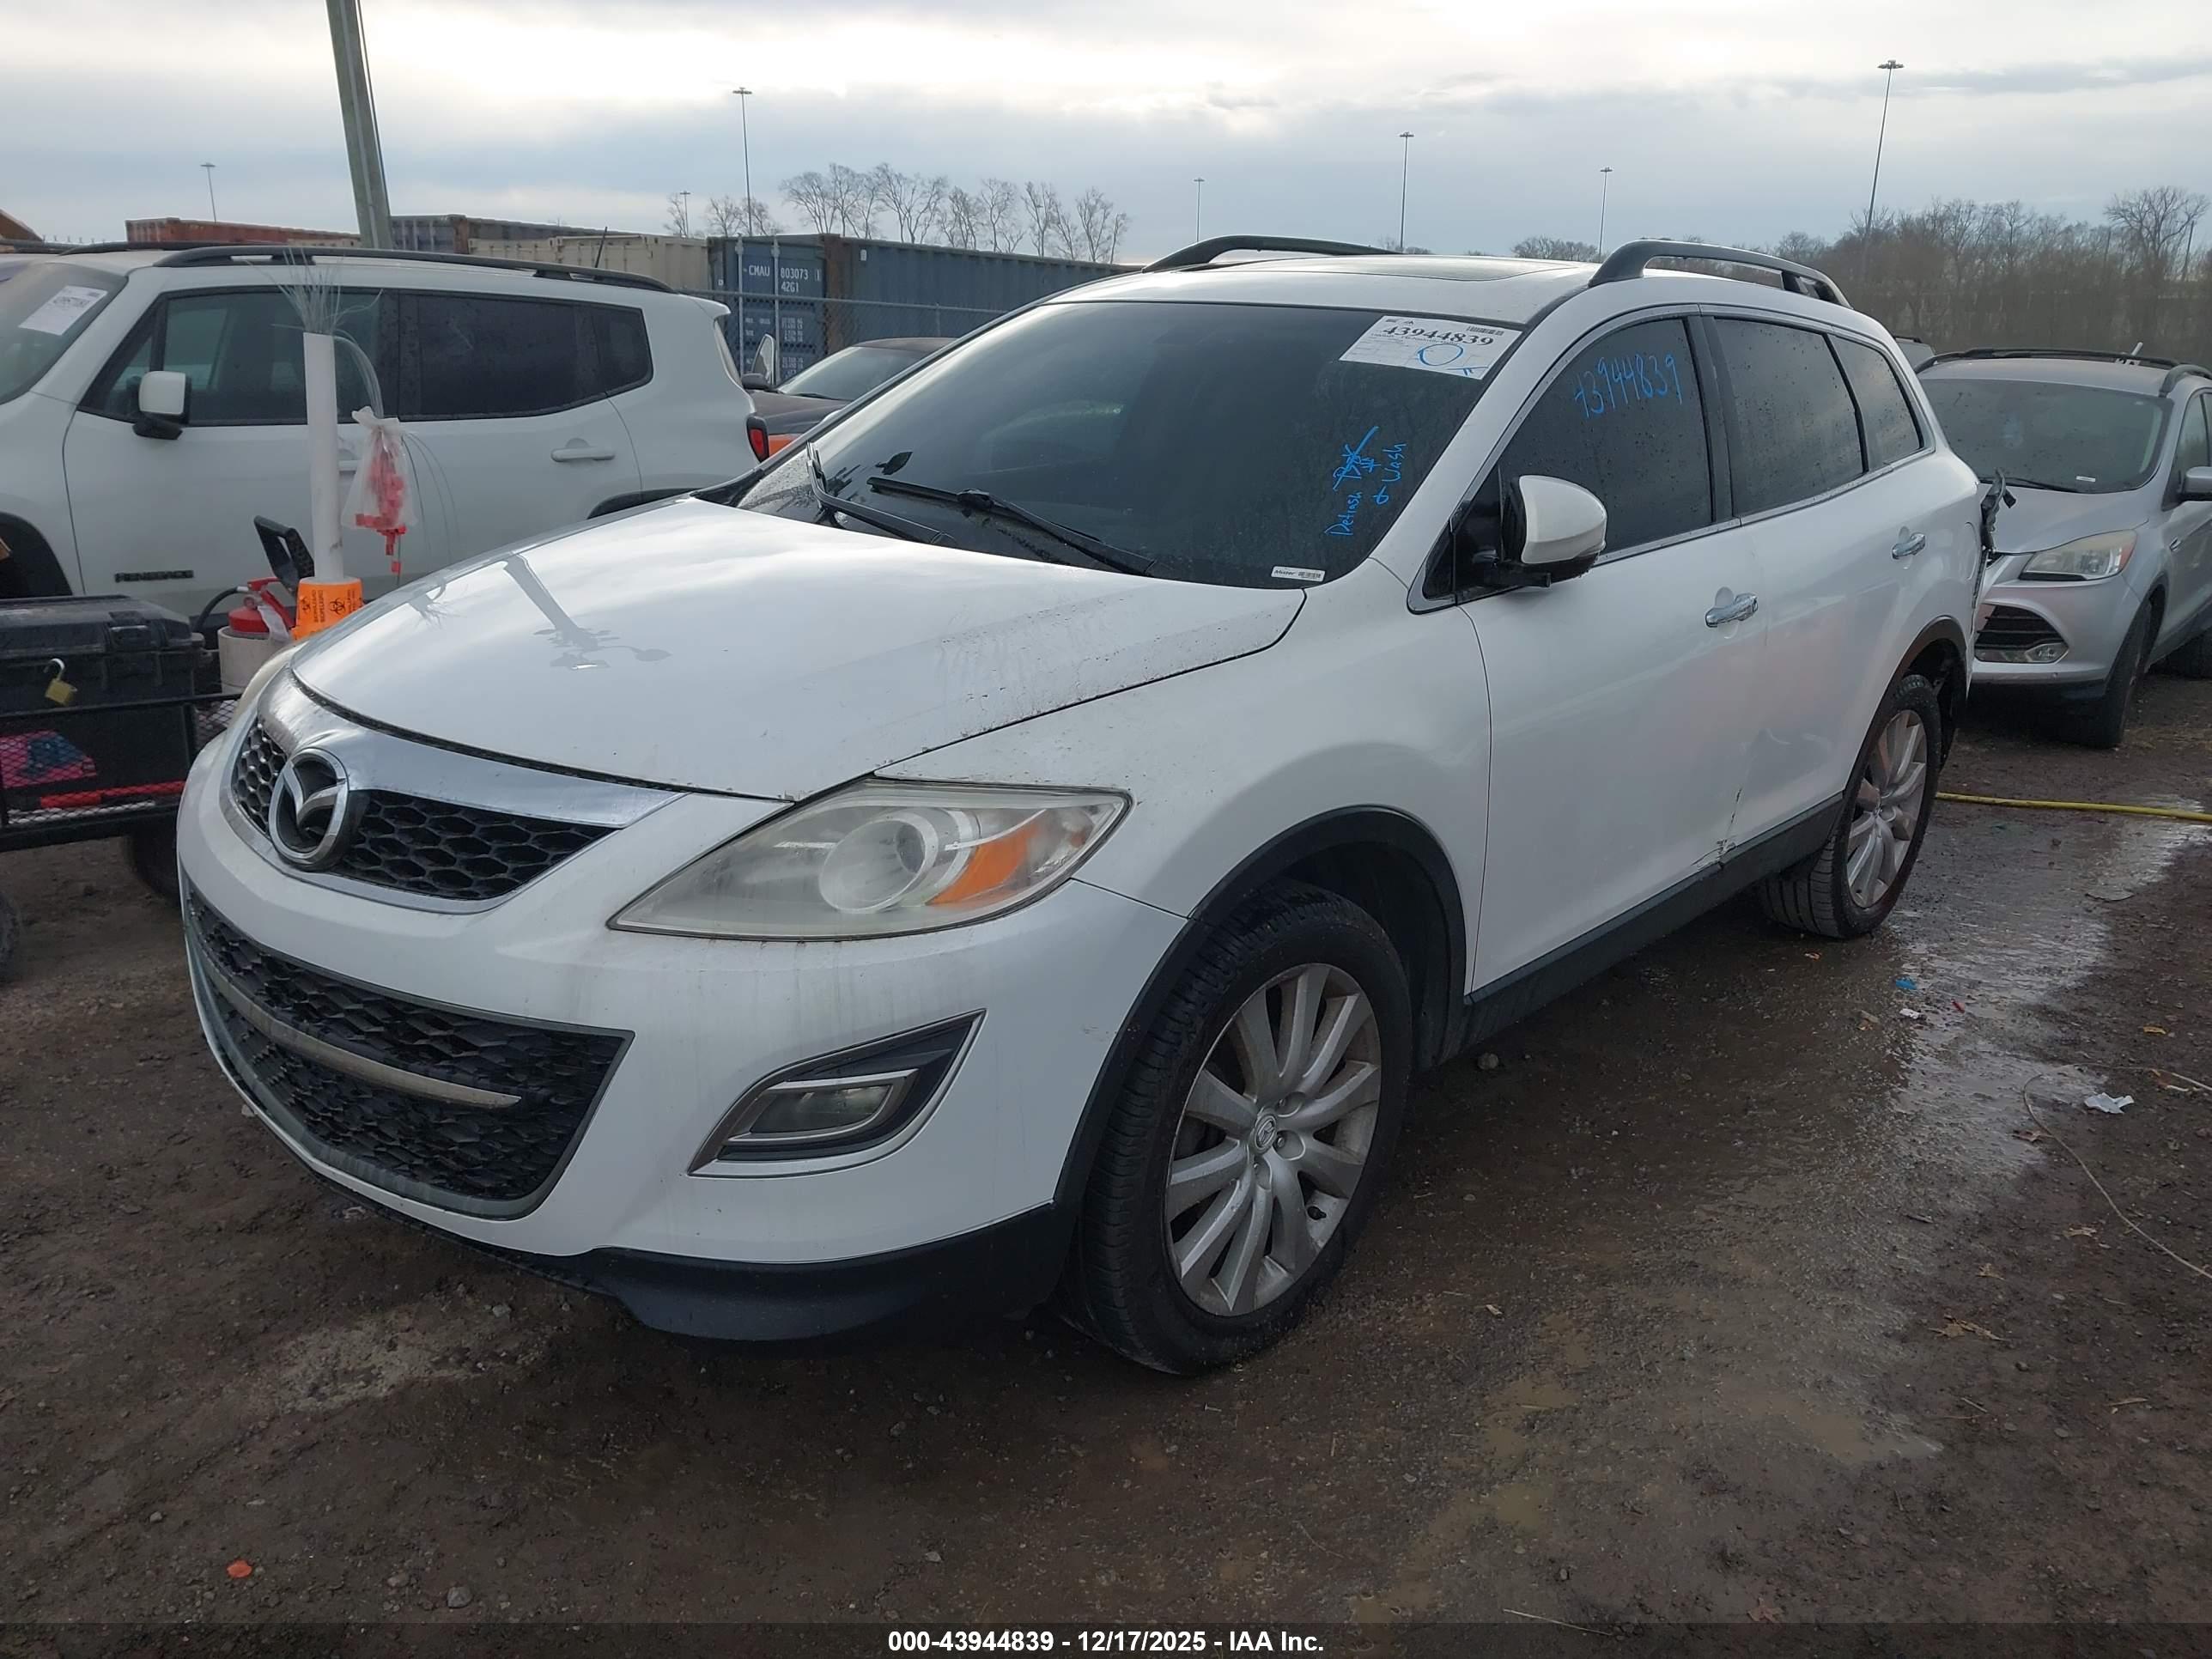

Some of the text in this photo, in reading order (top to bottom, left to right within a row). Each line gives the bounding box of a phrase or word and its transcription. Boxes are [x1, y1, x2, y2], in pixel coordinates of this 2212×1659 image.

[749, 264, 770, 277] CMAU
[780, 267, 809, 280] 803073
[781, 282, 799, 293] 42G1
[1382, 325, 1494, 346] 43944839
[1381, 442, 1407, 482] Wash
